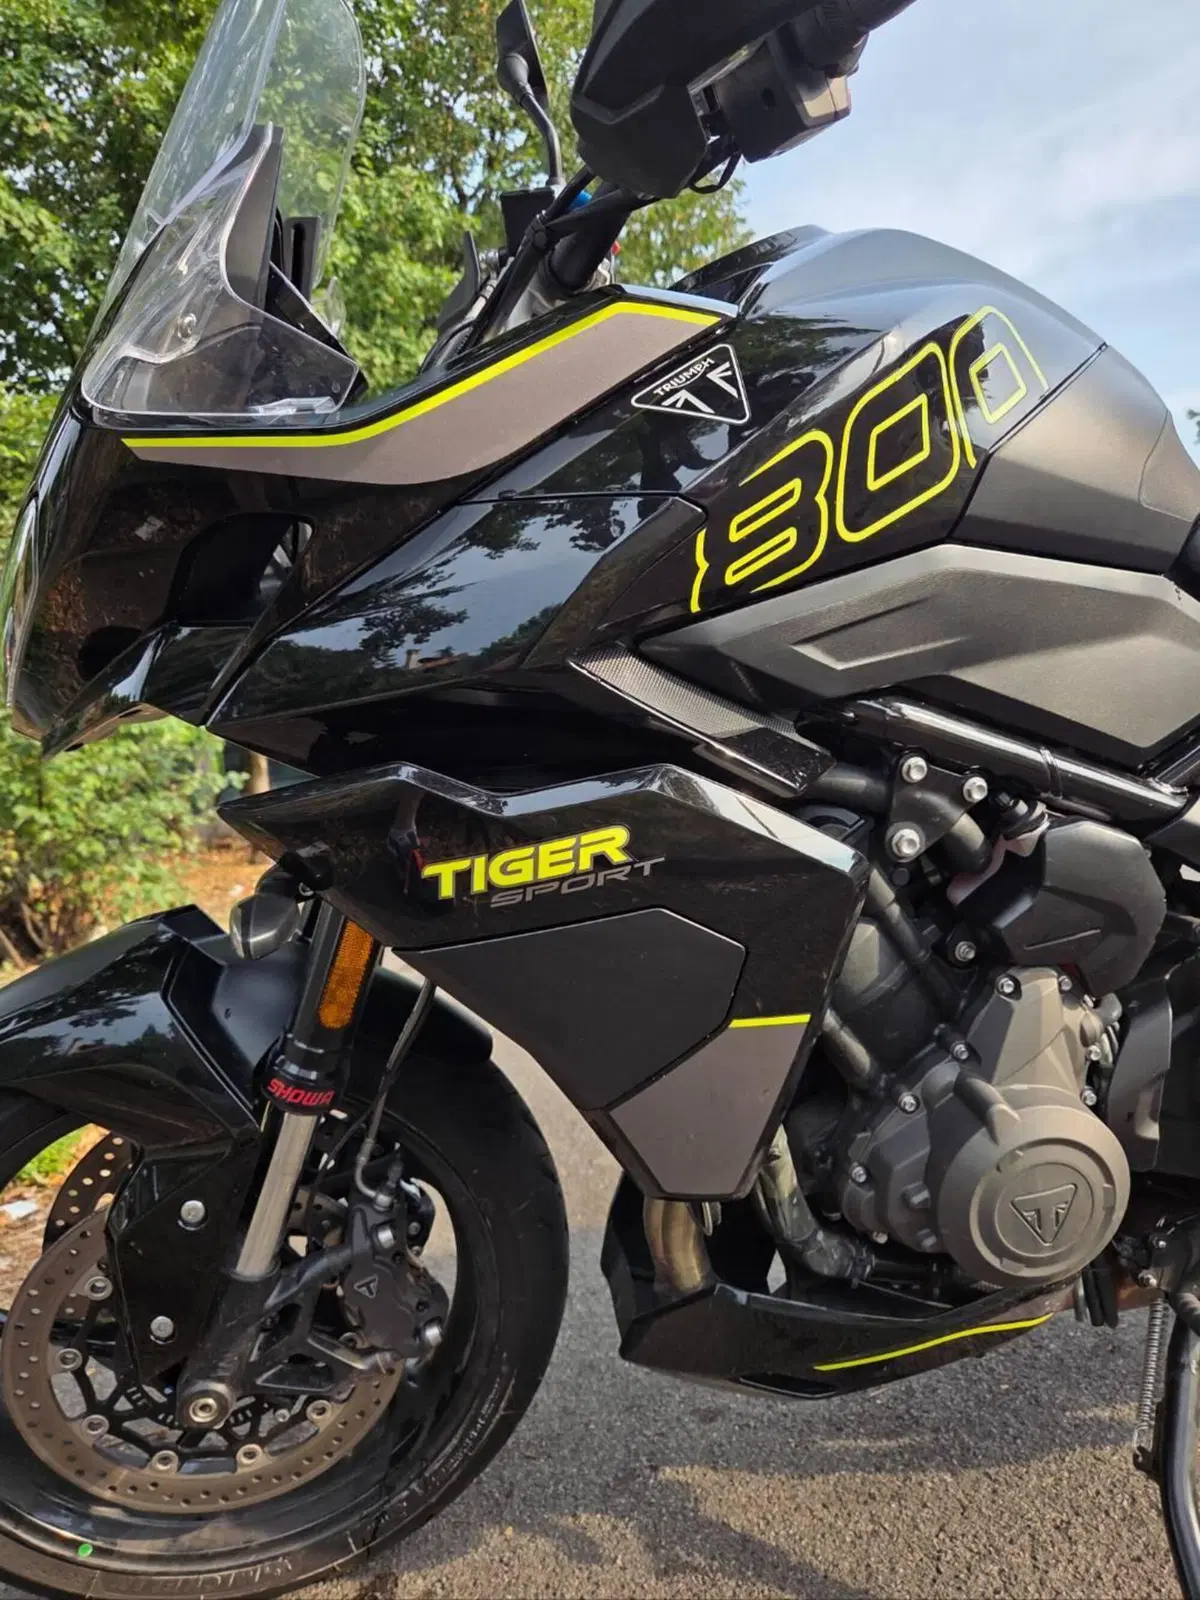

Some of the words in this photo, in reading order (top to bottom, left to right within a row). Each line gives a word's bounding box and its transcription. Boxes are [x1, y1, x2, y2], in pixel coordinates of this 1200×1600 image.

[653, 357, 715, 396] TRIUMPH
[690, 304, 1051, 614] 800
[421, 824, 631, 900] TIGER
[490, 856, 666, 908] SPORT
[267, 1078, 336, 1106] SHOWA
